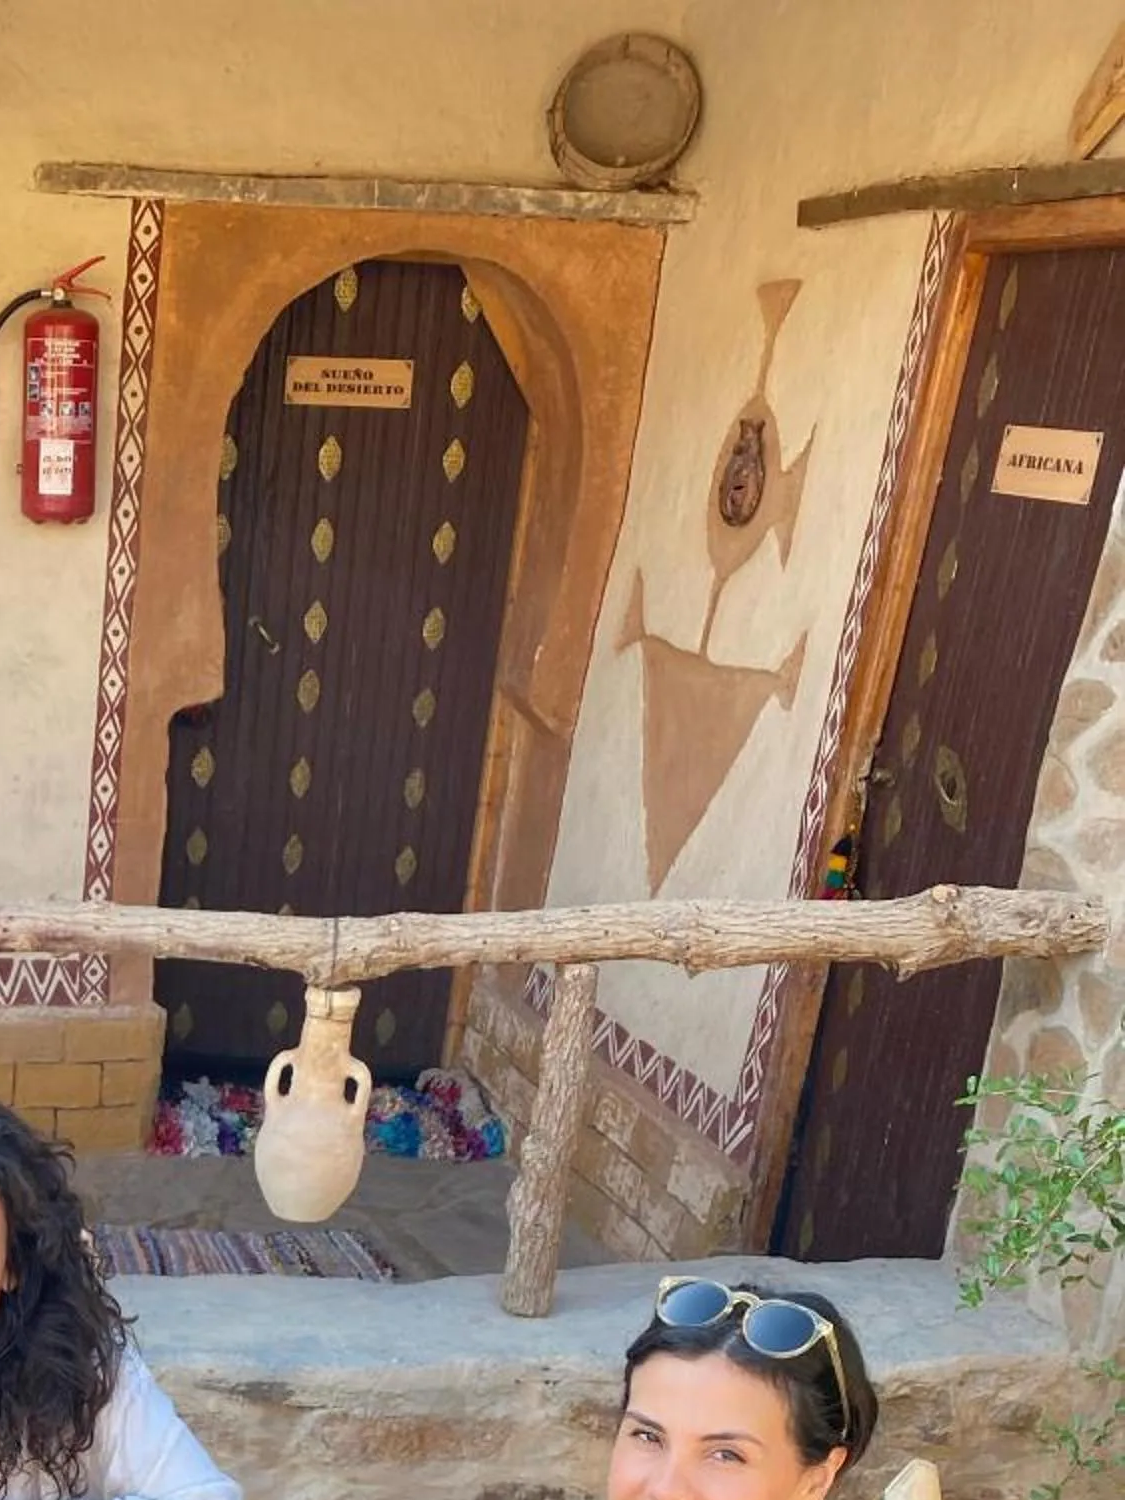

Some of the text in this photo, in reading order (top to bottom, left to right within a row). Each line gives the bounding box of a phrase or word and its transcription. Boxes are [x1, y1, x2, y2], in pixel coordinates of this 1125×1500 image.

[321, 367, 374, 381] SUEÑO
[292, 381, 404, 395] DEL DESIERTO
[1007, 453, 1083, 475] AFRICANA
